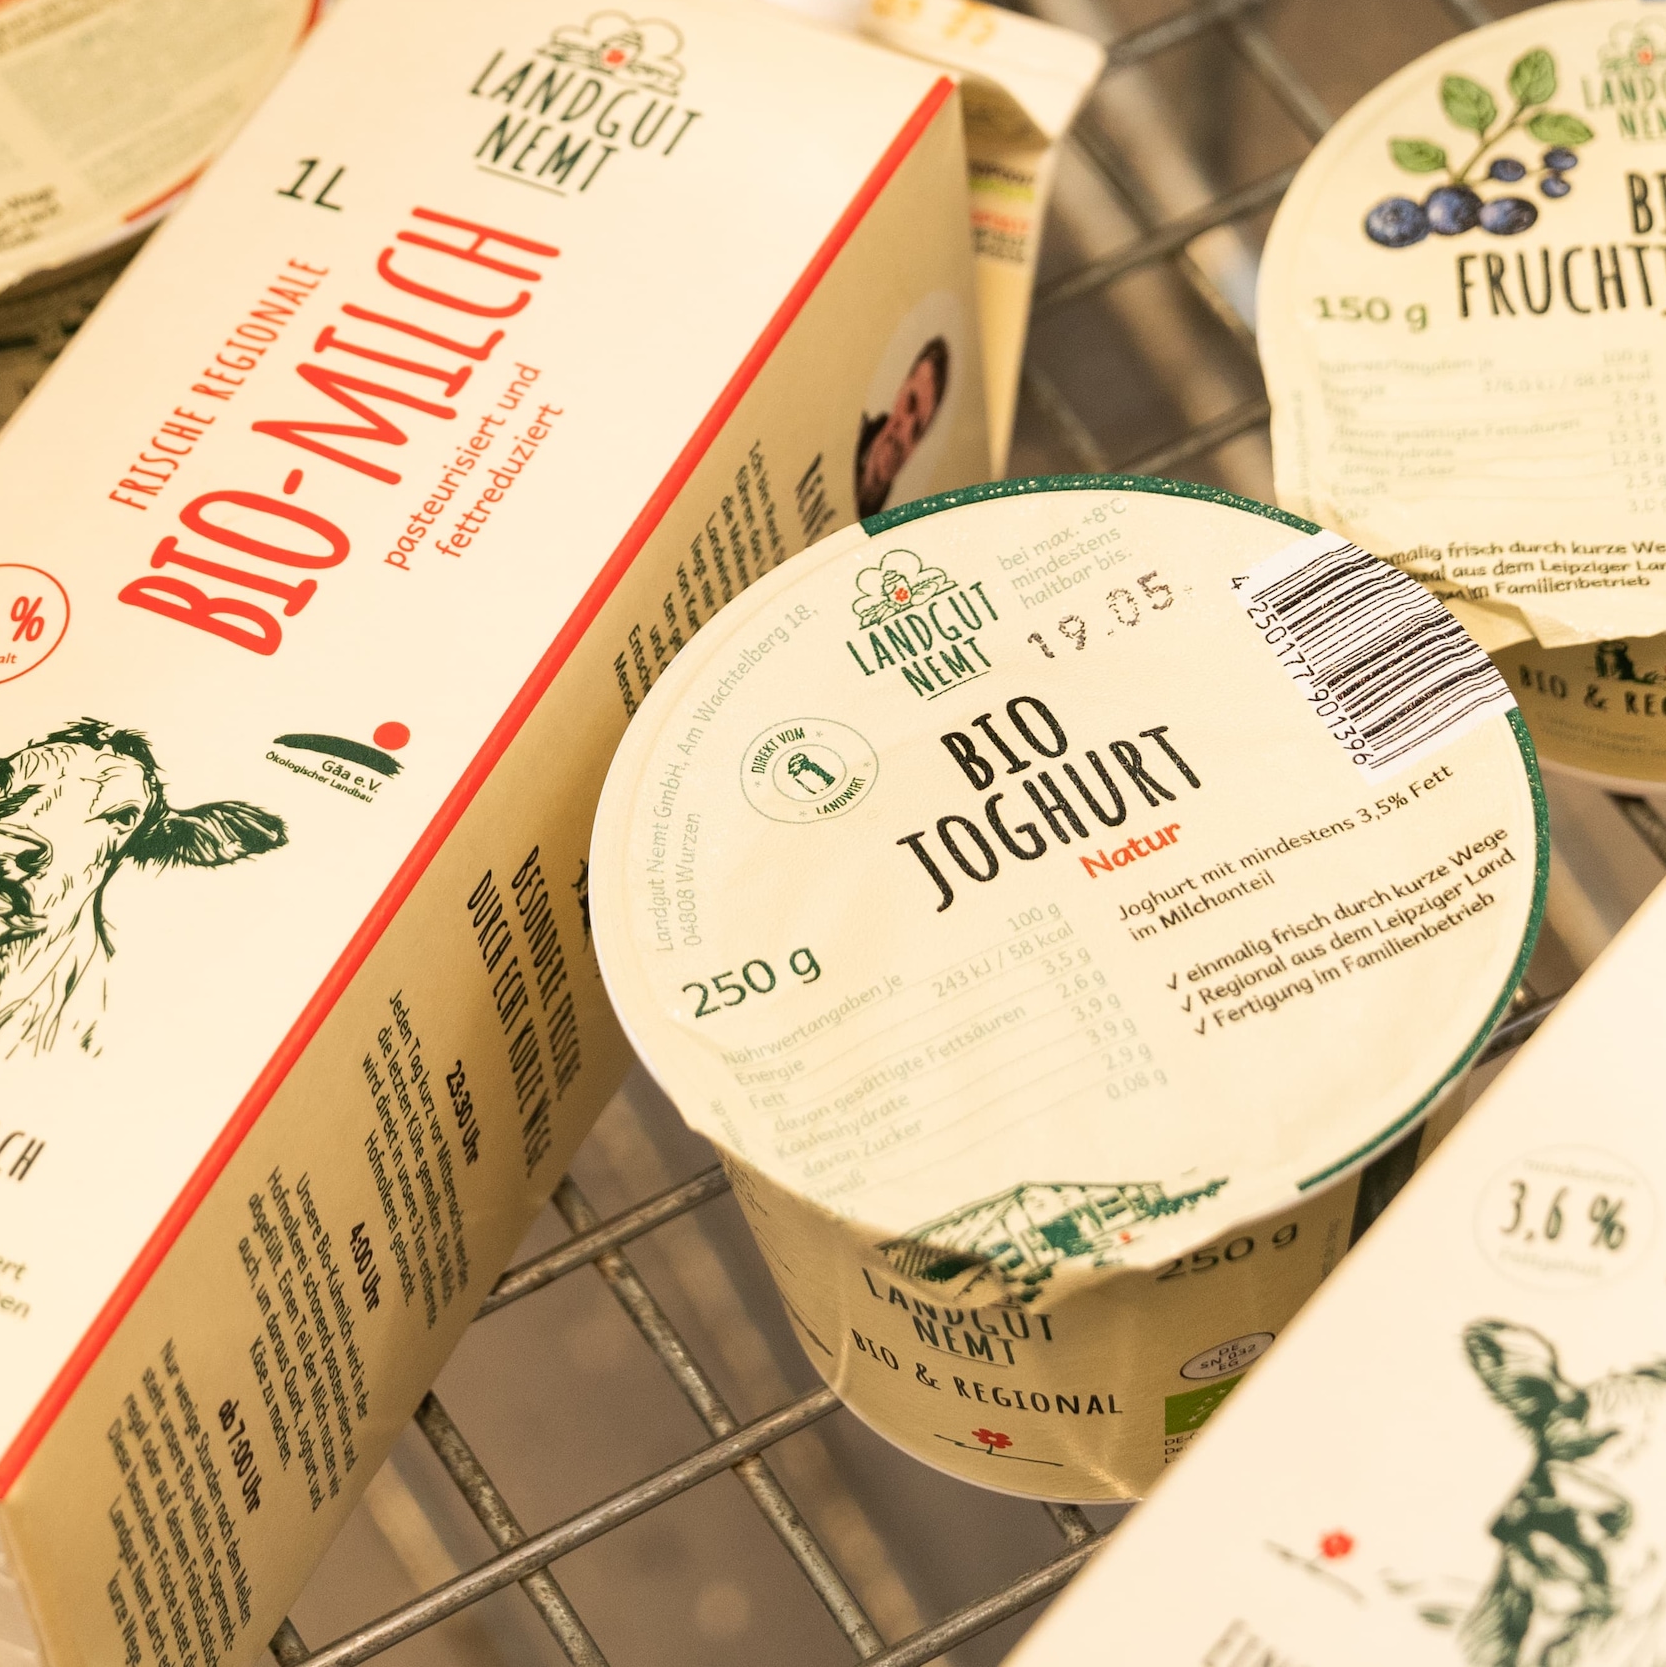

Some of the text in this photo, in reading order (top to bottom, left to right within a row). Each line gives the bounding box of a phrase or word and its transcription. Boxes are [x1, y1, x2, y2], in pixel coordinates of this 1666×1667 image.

[469, 50, 701, 157] LANDGUT
[277, 157, 346, 212] 1L
[475, 113, 618, 192] NEMT
[1316, 296, 1429, 331] 150 g
[108, 258, 329, 511] FRISCHE REGIONALE
[117, 206, 561, 657] BIO-MILCH
[383, 362, 541, 572] pasteurisiert und
[435, 404, 564, 558] fettreduziert
[998, 546, 1030, 570] bei
[1033, 527, 1074, 551] max.
[1011, 528, 1121, 590] mindestens
[1019, 567, 1090, 609] haltbar
[1231, 576, 1247, 590] 4
[9, 595, 46, 643] %
[846, 581, 999, 677] LANDGUT
[693, 627, 790, 722] Wachtelberg
[901, 636, 991, 697] NEMT
[1519, 665, 1568, 699] BIO
[1584, 684, 1607, 710] &
[265, 750, 373, 803] Ökologischer Landbau
[681, 727, 704, 756] Am
[750, 727, 806, 775] DIREKT VOM
[940, 695, 1069, 792] BIO
[816, 778, 866, 815] LANDWIRT
[895, 725, 1202, 913] JOGHURT
[646, 822, 669, 873] Nemt
[675, 813, 703, 947] 04808 Wurzen
[1079, 823, 1181, 879] Natur
[1119, 765, 1454, 921] Joghurt mit mindestens 3,5% Fett
[647, 878, 674, 952] Landgut
[1130, 869, 1275, 942] im Milchanteil
[1186, 829, 1509, 983] einmalig frisch durch kurze Wege
[1198, 845, 1516, 1006] Regional aus dem Leipziger Land
[511, 845, 581, 1094] BESONDERE FRISCHE
[681, 947, 822, 1019] 250 g
[1212, 892, 1495, 1028] Fertigung im Familienbetrieb
[466, 869, 551, 1175] DURCH ECHT KURZE WEGE
[445, 1059, 480, 1166] 23:30 Uhr
[1271, 1223, 1299, 1249] g
[1502, 1180, 1626, 1251] 3,6 %
[296, 1173, 369, 1420] Unsere Bio-Kuhmilch wird in der
[349, 1221, 382, 1313] 4:00 Uhr
[851, 1328, 1117, 1415] BIO & REGIONAL
[912, 1316, 1015, 1365] NEMT
[218, 1399, 262, 1514] ab 7:00 Uhr
